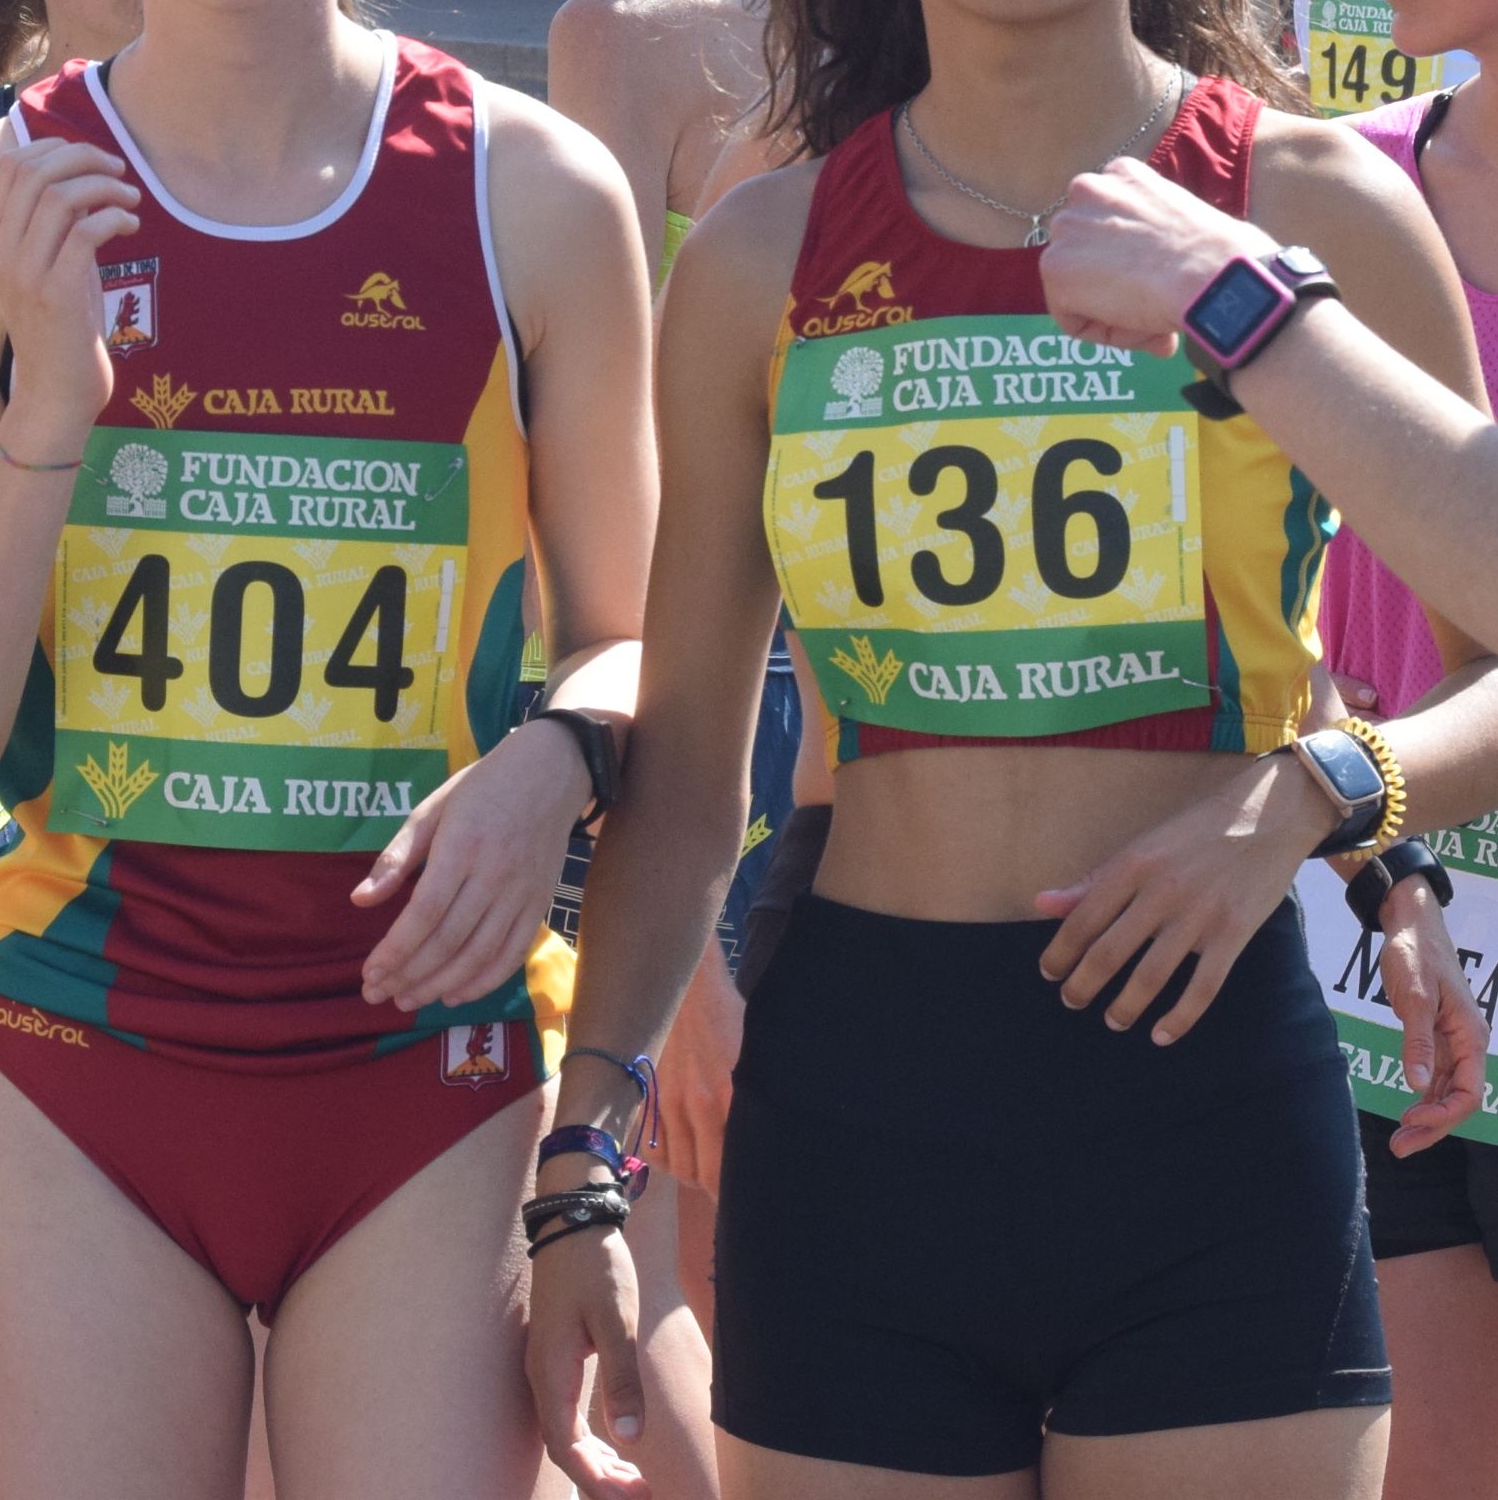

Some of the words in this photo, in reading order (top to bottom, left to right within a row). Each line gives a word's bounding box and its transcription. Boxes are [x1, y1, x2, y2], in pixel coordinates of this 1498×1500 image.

[1338, 2, 1396, 20] FUNDAC
[1338, 18, 1369, 32] CAJA
[1321, 41, 1417, 105] 149
[892, 333, 1135, 375] FUNDACION
[203, 388, 282, 416] CAJA
[290, 388, 396, 417] RURAL
[892, 374, 982, 414] CAJA
[993, 369, 1135, 407] RURAL
[180, 452, 422, 497] FUNDACION
[179, 489, 288, 529] CAJA
[297, 495, 416, 531] RURAL
[813, 438, 1132, 608] 136
[93, 554, 415, 722] 404
[907, 658, 1008, 703] CAJA
[1016, 650, 1180, 702] RURAL
[163, 772, 270, 814] CAJA
[283, 777, 412, 818] RURAL
